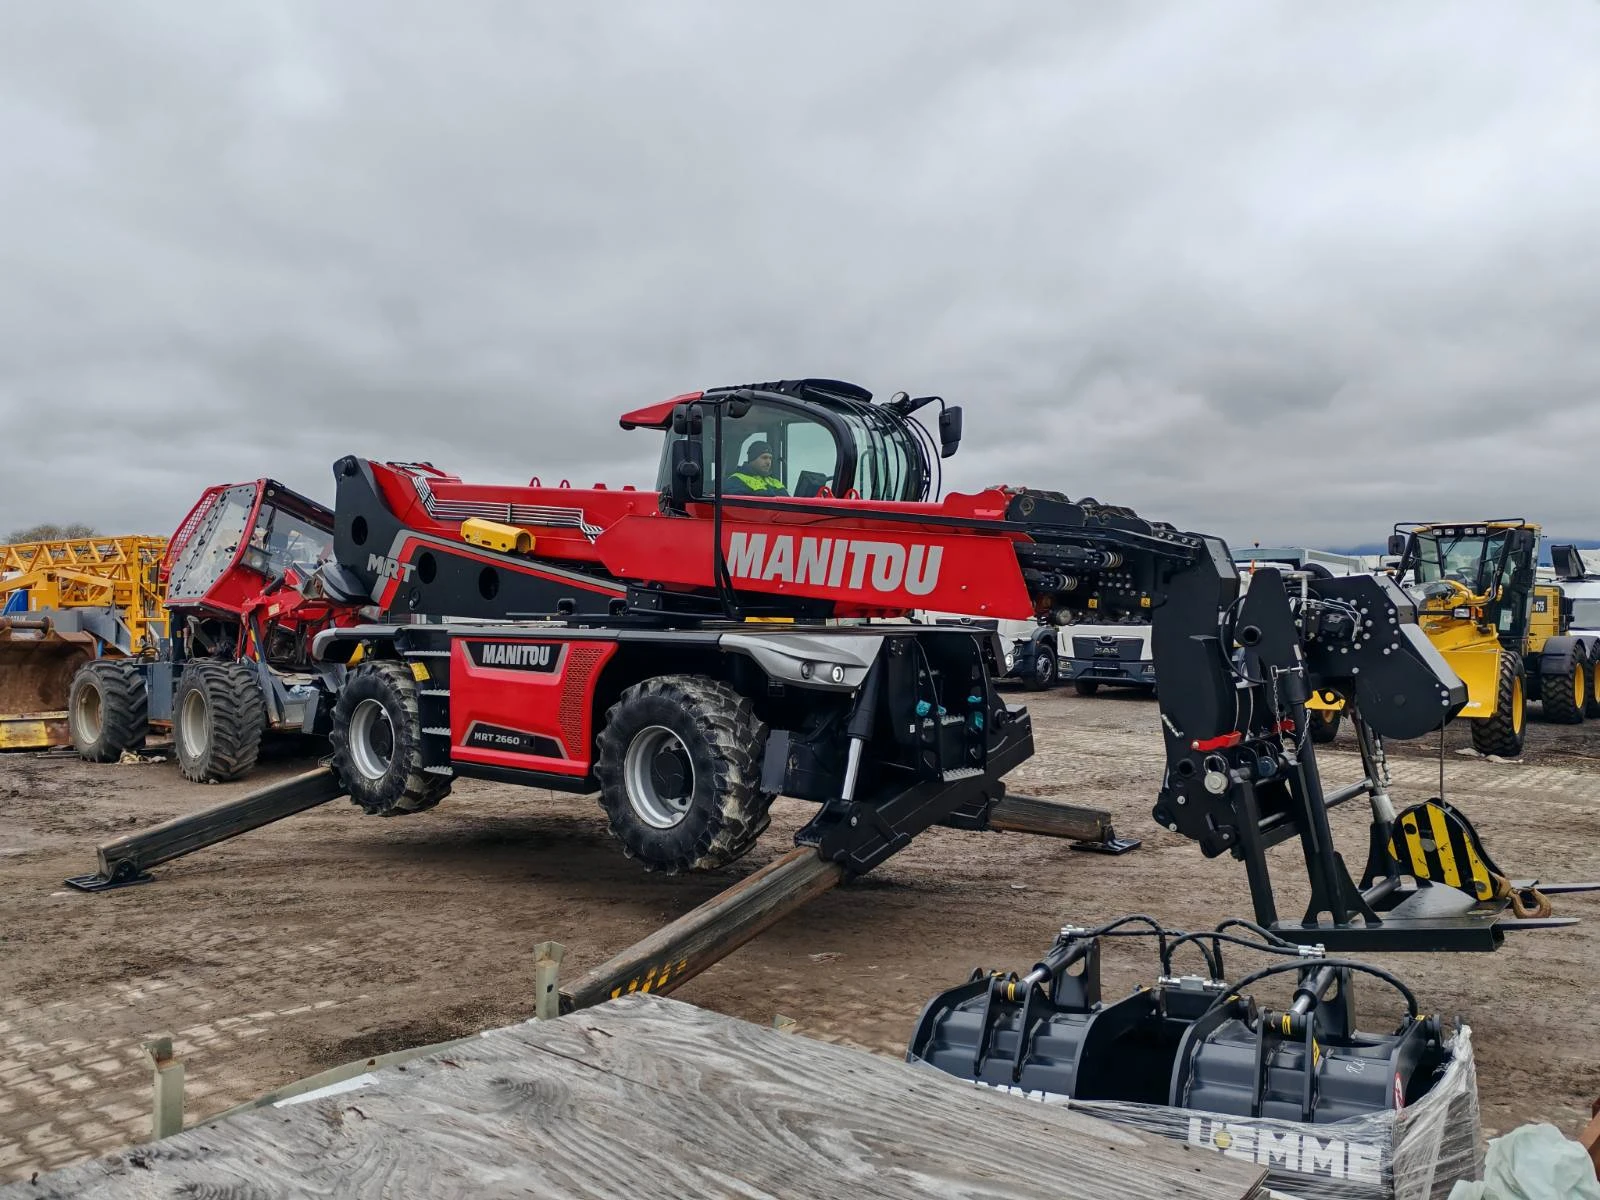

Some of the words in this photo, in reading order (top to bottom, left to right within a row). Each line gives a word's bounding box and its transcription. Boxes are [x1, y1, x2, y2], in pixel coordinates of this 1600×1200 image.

[366, 553, 417, 583] MRT
[726, 531, 945, 596] MANITOU
[482, 644, 551, 666] MANITOU
[474, 732, 494, 742] MRT
[495, 734, 520, 745] 2660
